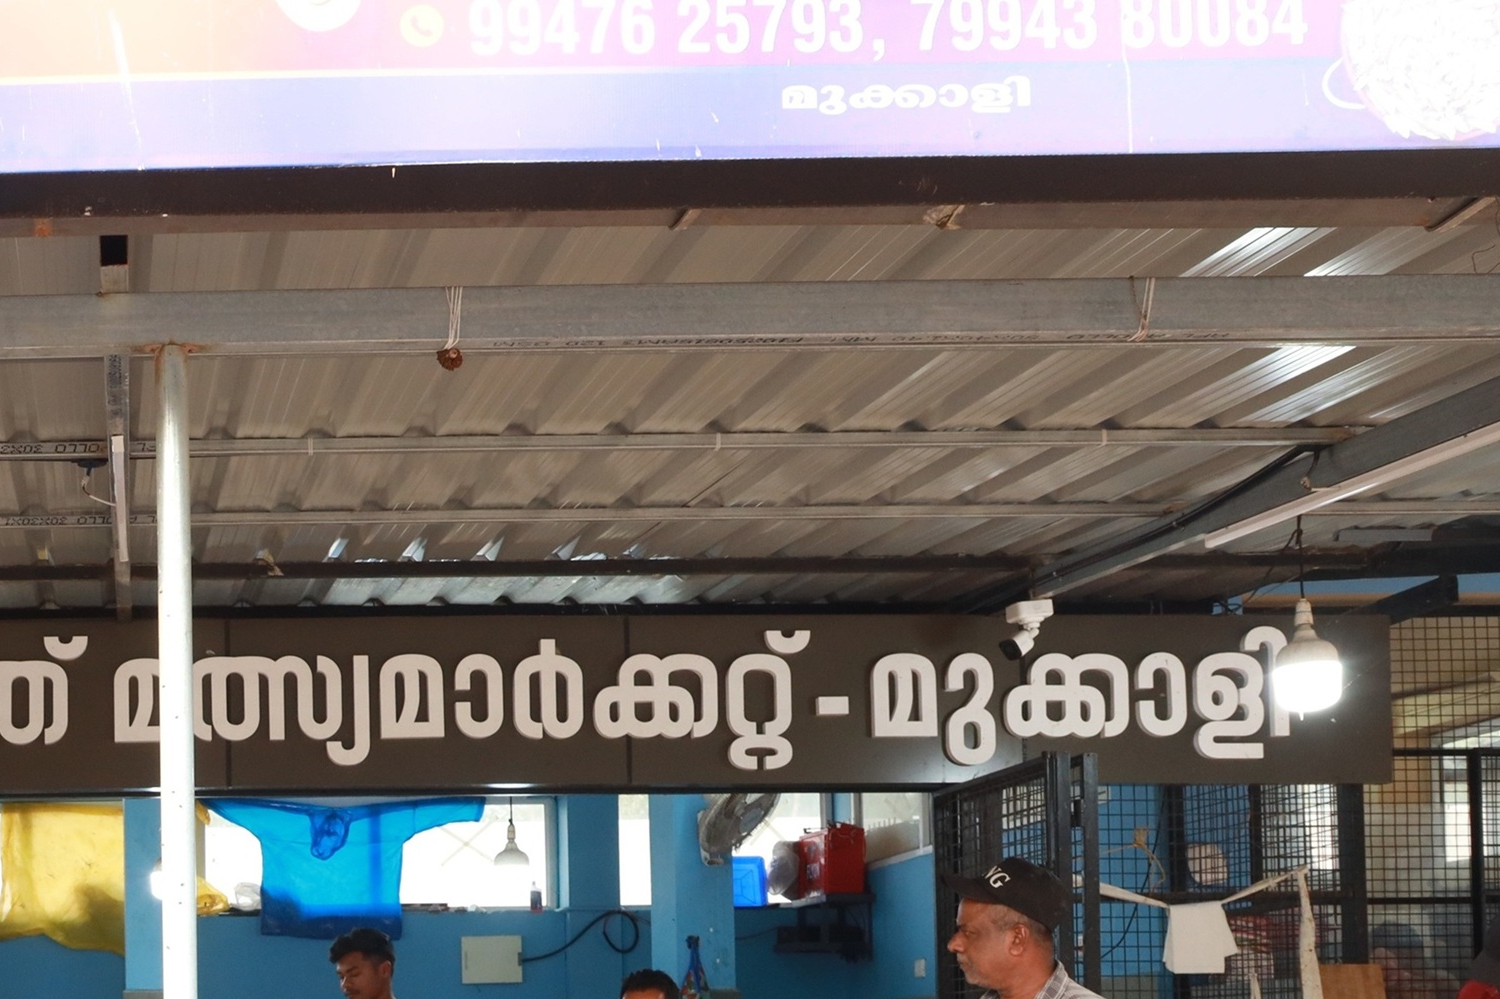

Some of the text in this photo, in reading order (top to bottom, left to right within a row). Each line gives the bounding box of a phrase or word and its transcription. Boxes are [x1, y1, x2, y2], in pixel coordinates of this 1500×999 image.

[468, 0, 1309, 61] 99476 25793, 79943 80084
[781, 75, 1032, 115] മുക്കാളി
[870, 625, 1291, 767] മുക്കാളി
